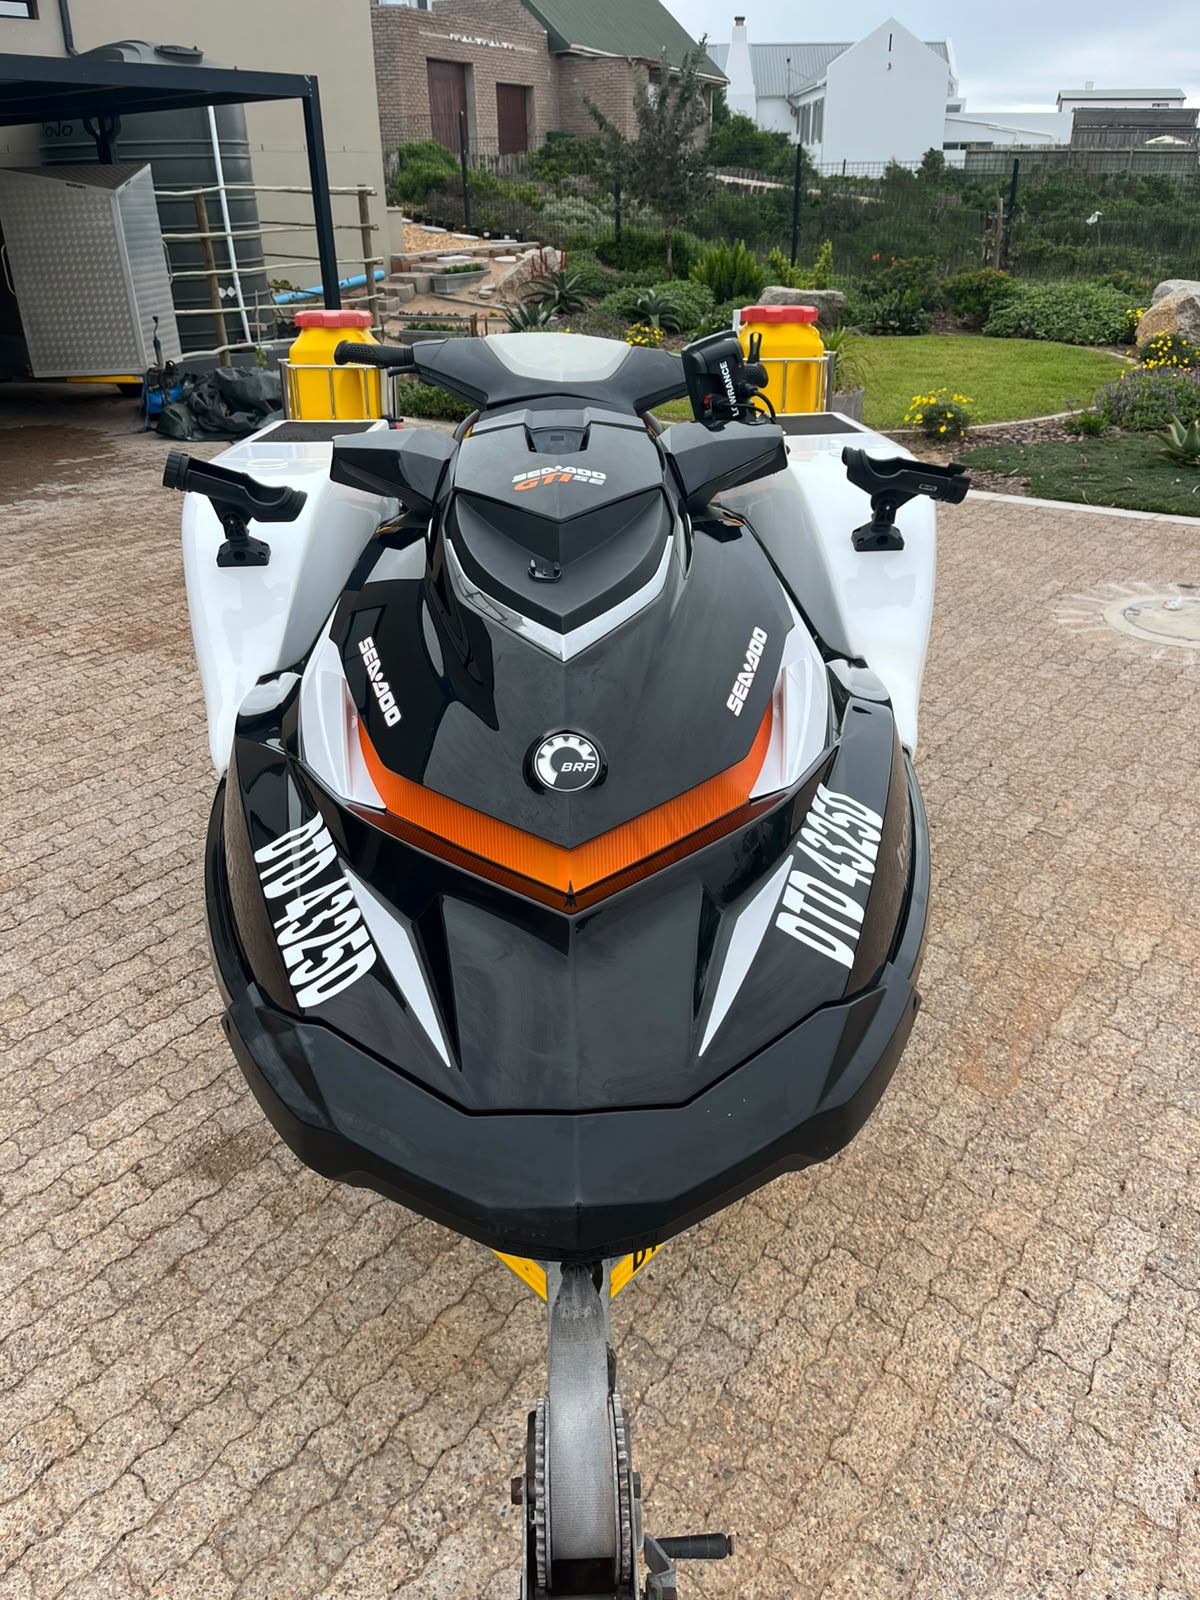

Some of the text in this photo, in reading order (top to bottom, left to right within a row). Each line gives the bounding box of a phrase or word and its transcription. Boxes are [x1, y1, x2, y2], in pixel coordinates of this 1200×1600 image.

[513, 472, 573, 491] GTI
[561, 762, 596, 772] BRP
[254, 811, 377, 1008] DTD 43250
[775, 782, 884, 969] DTD 43250
